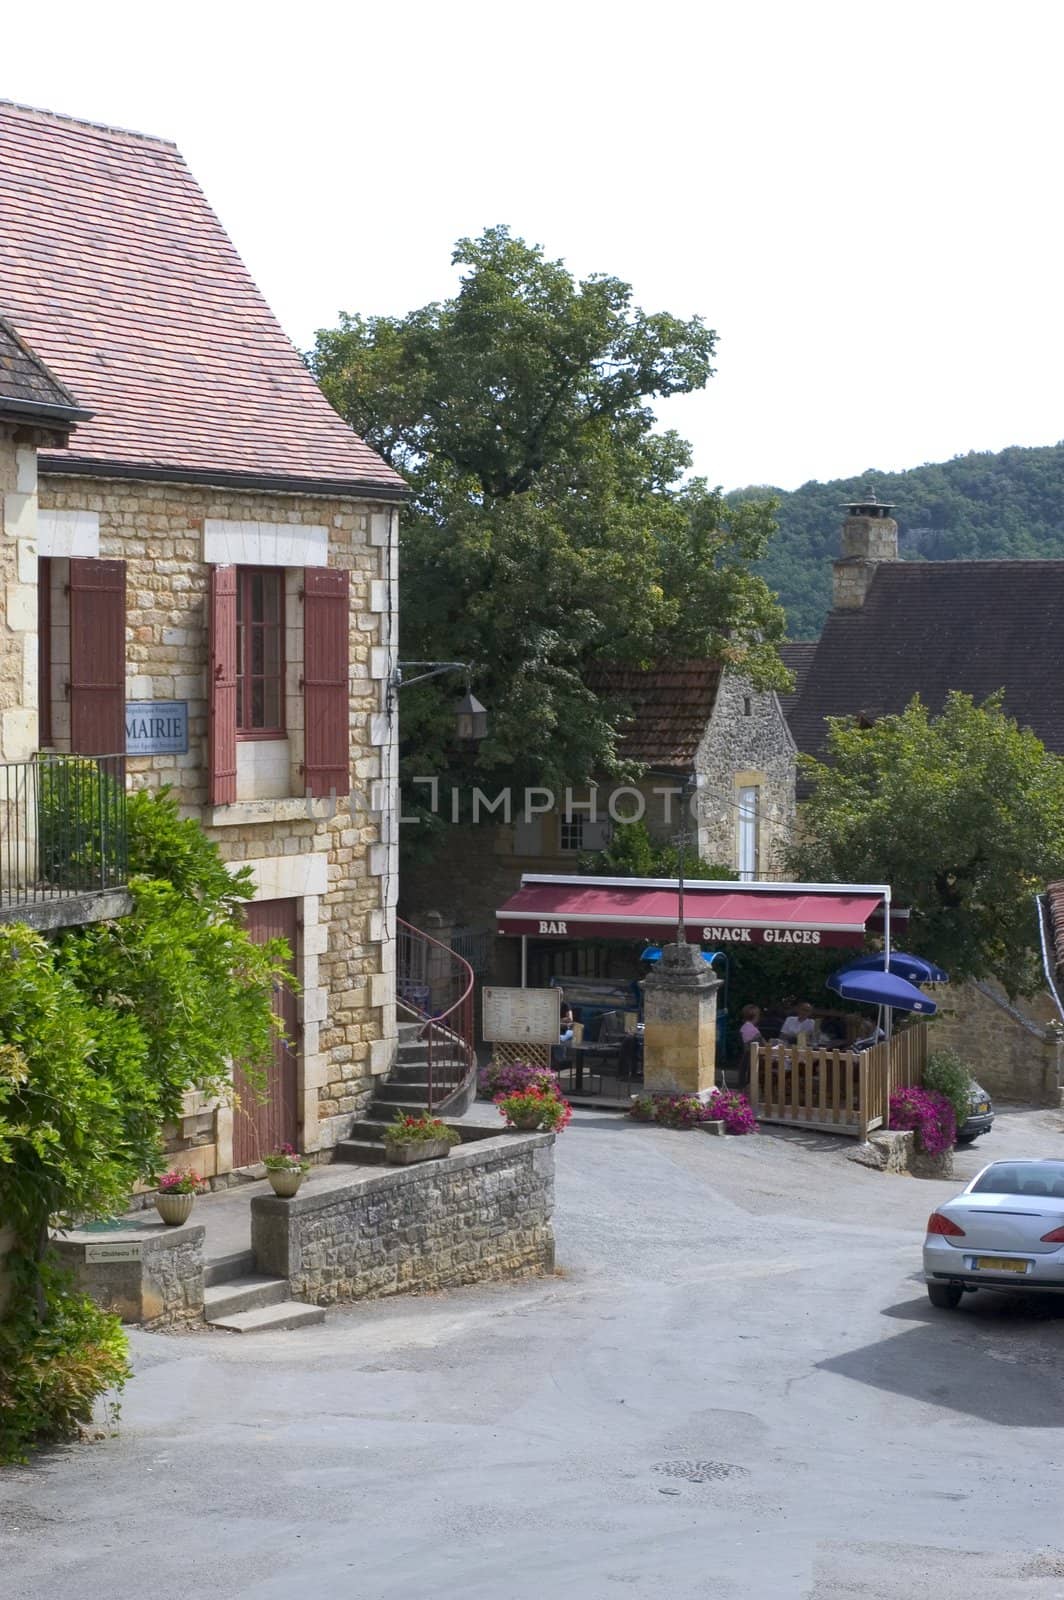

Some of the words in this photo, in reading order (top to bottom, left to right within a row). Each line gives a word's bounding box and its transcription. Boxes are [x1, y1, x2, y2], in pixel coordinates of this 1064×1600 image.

[125, 718, 182, 739] MAIRIE
[539, 920, 568, 934] BAR
[702, 927, 752, 942] SNACK
[763, 929, 821, 944] GLACES
